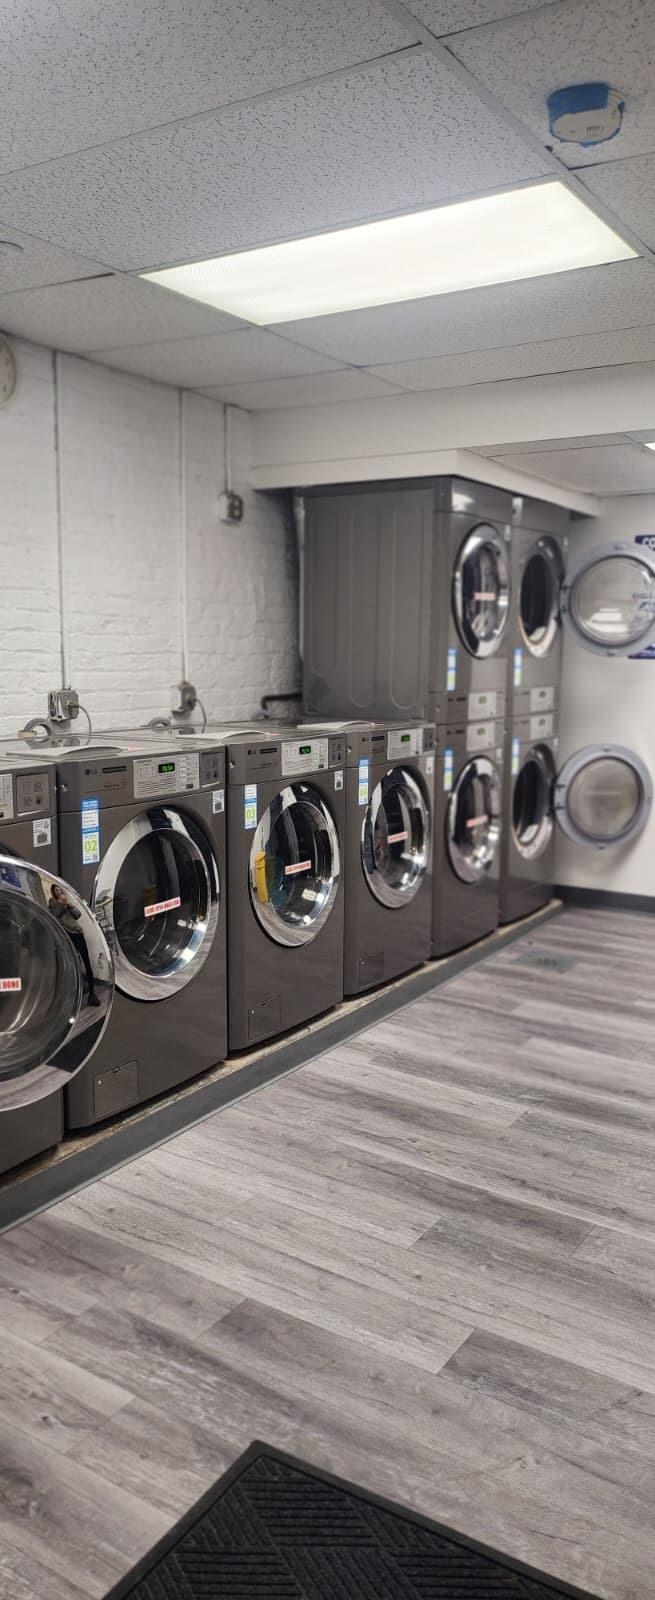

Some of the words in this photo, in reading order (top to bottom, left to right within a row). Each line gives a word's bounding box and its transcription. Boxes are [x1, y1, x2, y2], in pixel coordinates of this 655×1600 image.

[247, 809, 255, 819] 03
[85, 840, 98, 853] 02
[3, 980, 19, 990] DONE
